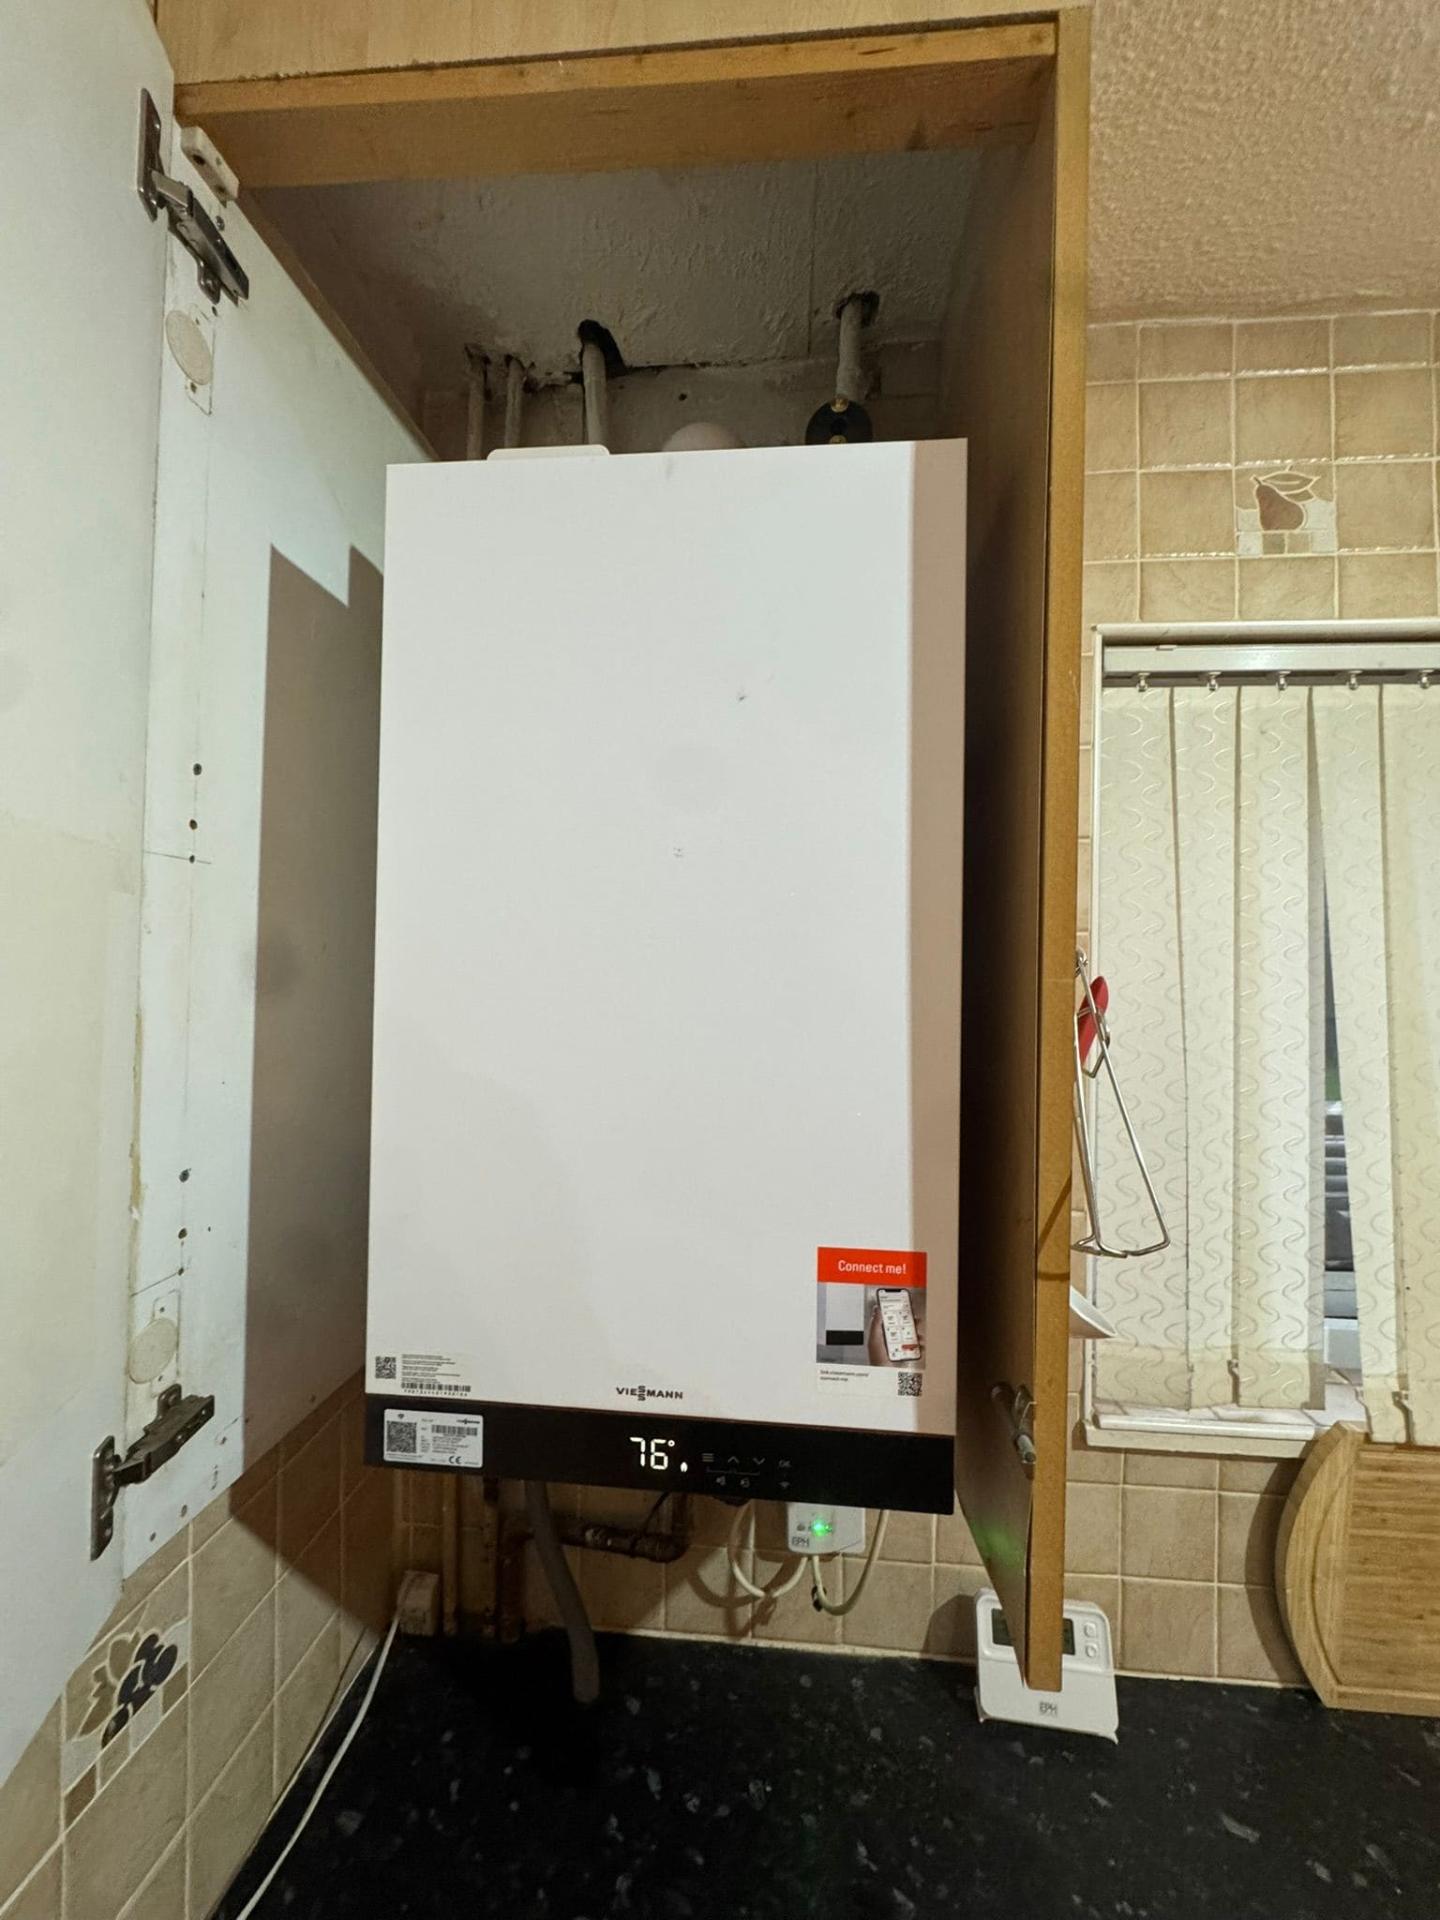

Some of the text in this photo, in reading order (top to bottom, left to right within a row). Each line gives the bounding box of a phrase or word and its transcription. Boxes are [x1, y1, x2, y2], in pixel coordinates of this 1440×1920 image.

[838, 1260, 906, 1275] Connect me!
[616, 1385, 684, 1402] VIESSMANN
